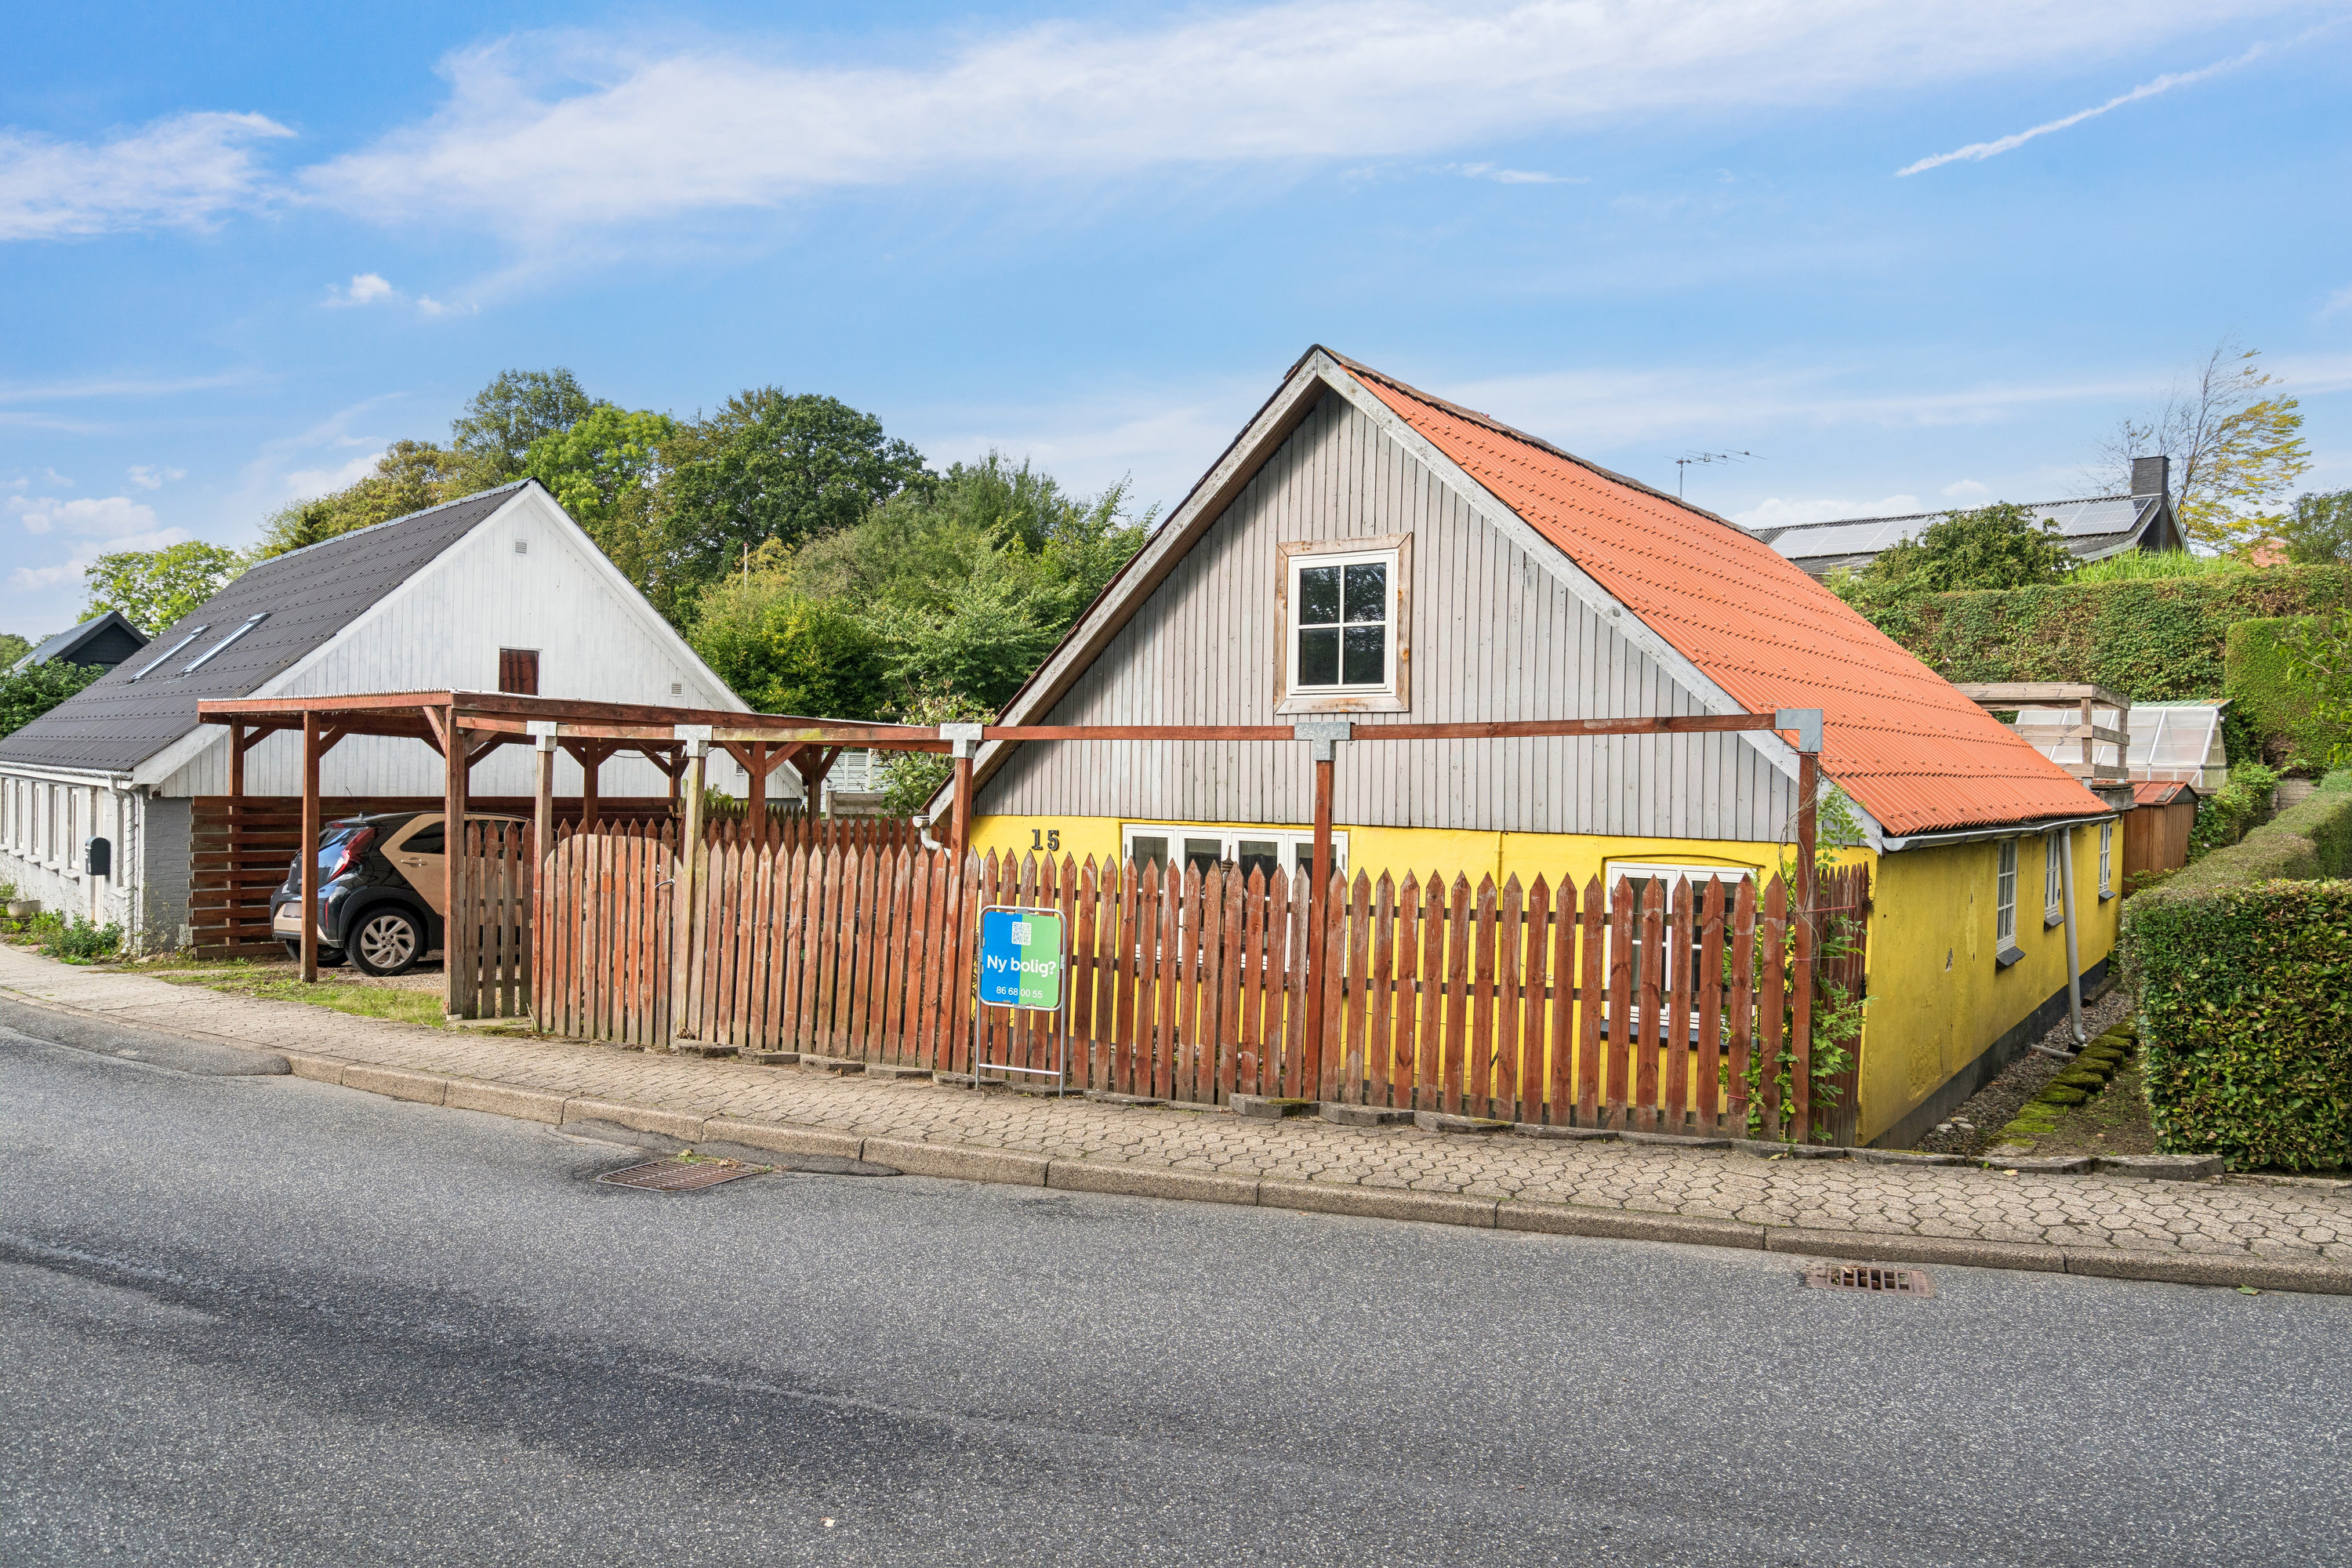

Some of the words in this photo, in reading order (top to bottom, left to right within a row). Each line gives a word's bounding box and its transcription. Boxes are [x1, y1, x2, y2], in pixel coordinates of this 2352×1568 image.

[1031, 829, 1059, 851] 15
[986, 954, 1007, 973] Ny
[1010, 956, 1057, 978] bolig?
[996, 985, 1007, 995] 86
[1007, 987, 1018, 996] 68
[1020, 989, 1031, 997] 00
[1032, 989, 1043, 999] 55
